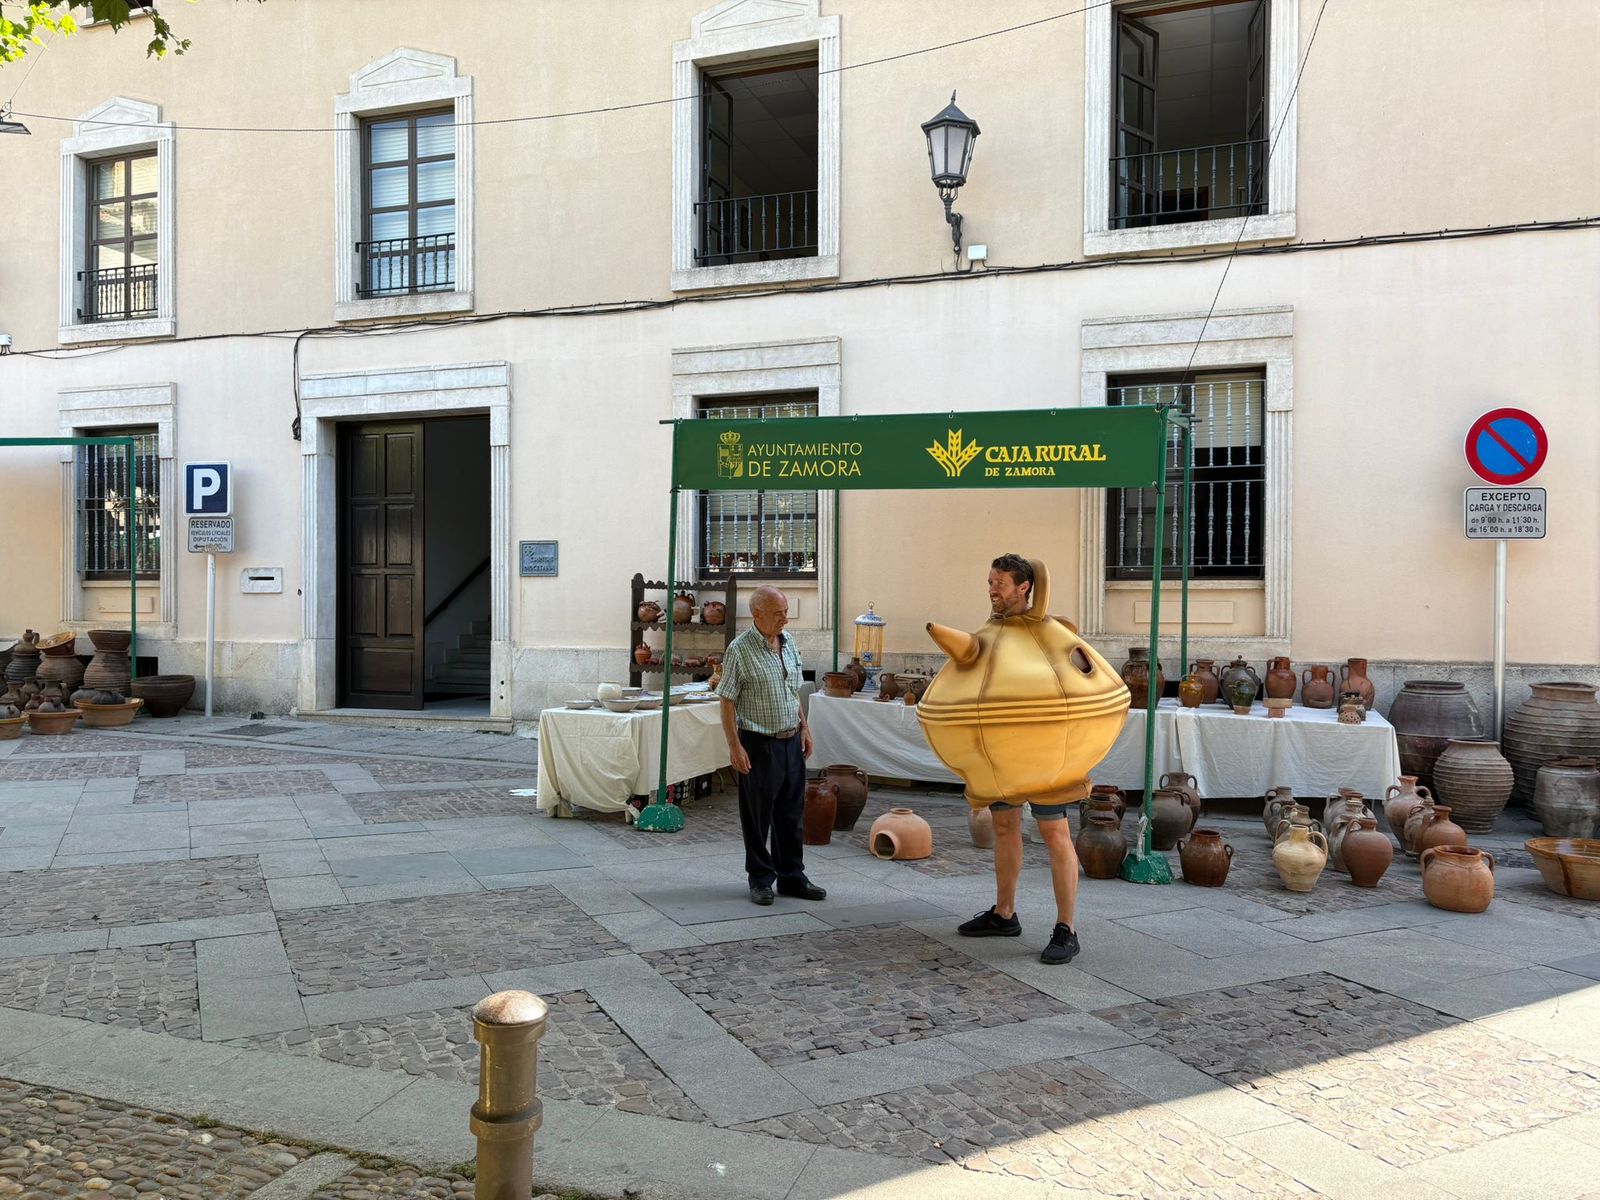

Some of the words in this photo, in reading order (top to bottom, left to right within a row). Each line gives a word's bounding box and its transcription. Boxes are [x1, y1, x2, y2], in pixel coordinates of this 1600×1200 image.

[747, 442, 862, 457] AYUNTAMIENTO
[985, 445, 1034, 464] CAJA
[1035, 444, 1107, 462] RURAL
[748, 460, 772, 477] DE
[778, 459, 862, 477] ZAMORA
[984, 467, 1000, 477] DE
[1005, 466, 1056, 477] ZAMORA
[193, 468, 221, 510] P
[1481, 492, 1531, 501] EXCEPTO
[1469, 503, 1495, 512] CARGA
[1496, 503, 1501, 512] Y
[1502, 503, 1543, 512] DESCARGA
[190, 520, 231, 529] RESERVADO
